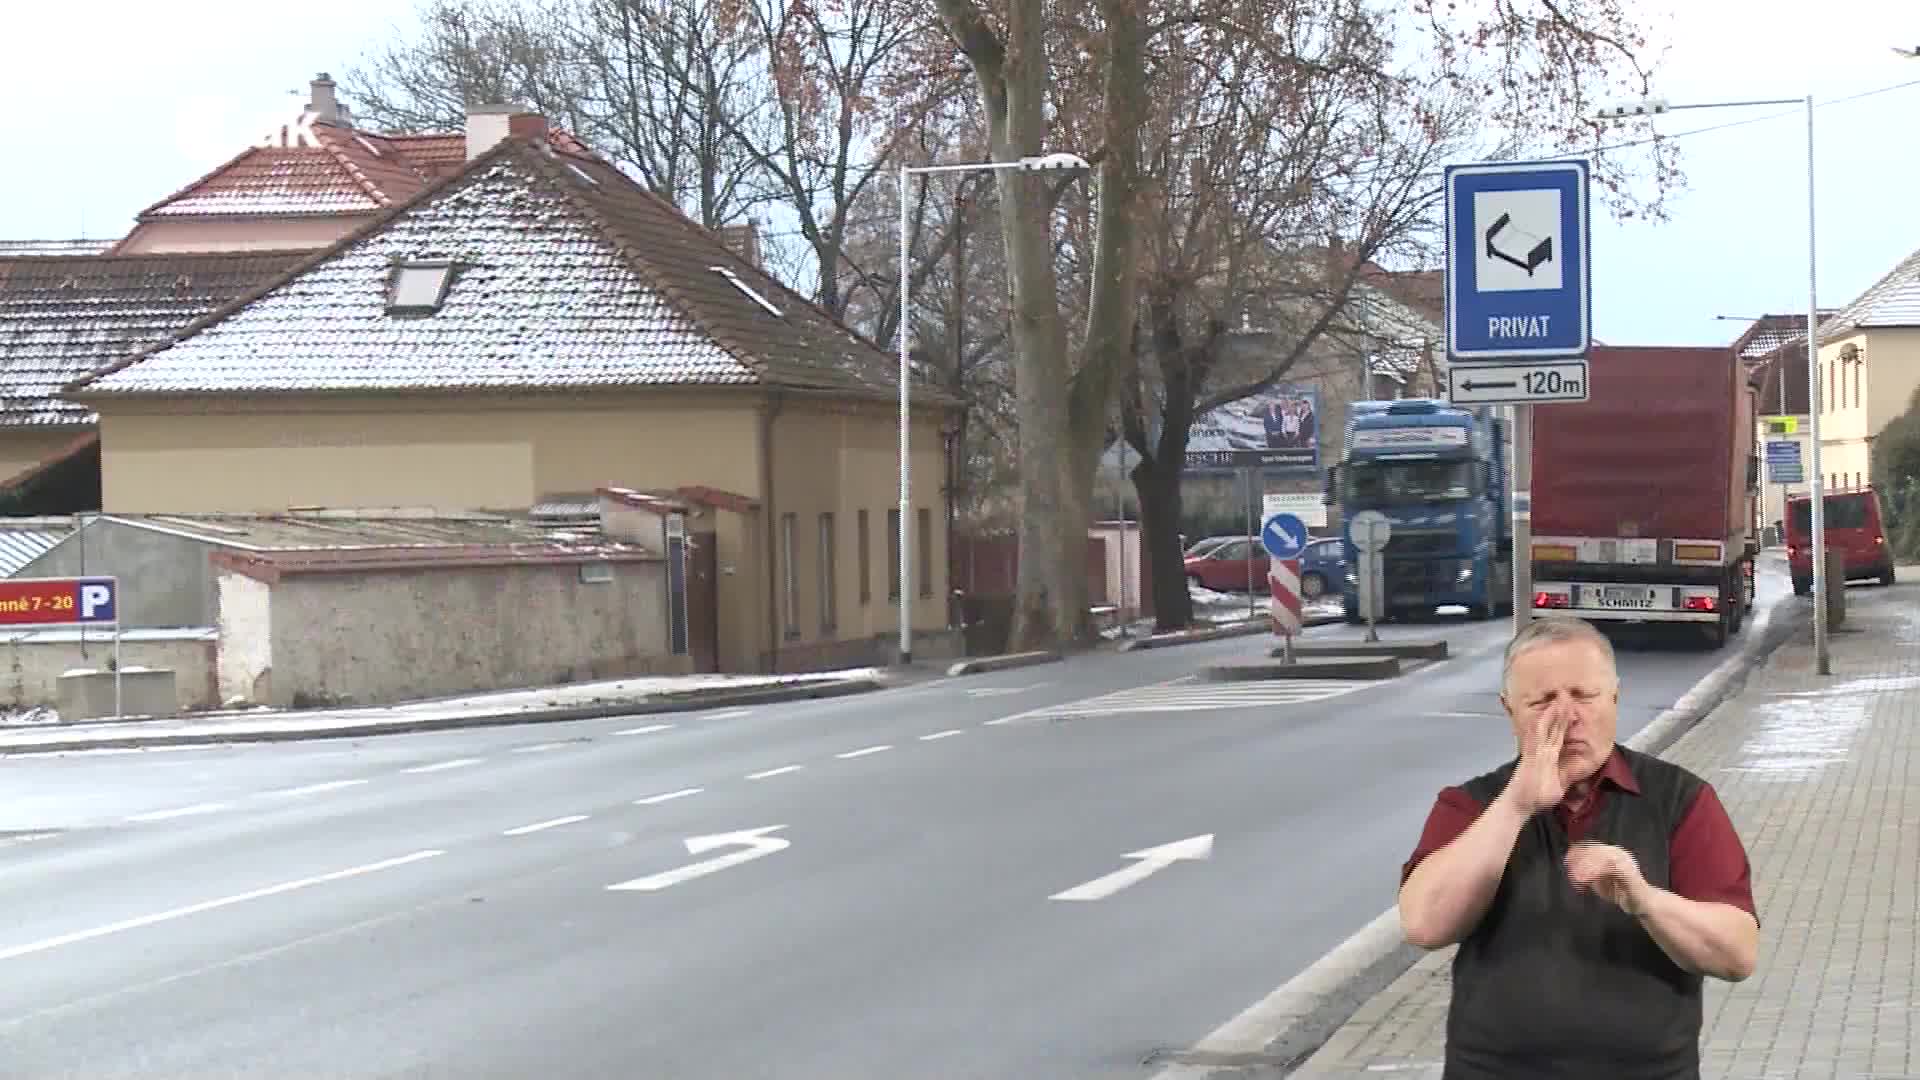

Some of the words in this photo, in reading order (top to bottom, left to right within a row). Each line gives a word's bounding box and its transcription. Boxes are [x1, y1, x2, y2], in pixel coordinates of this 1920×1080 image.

[1488, 315, 1550, 339] PRIVAT
[1522, 370, 1580, 394] 120m
[81, 585, 110, 618] P
[1599, 598, 1654, 608] SCHMITZ
